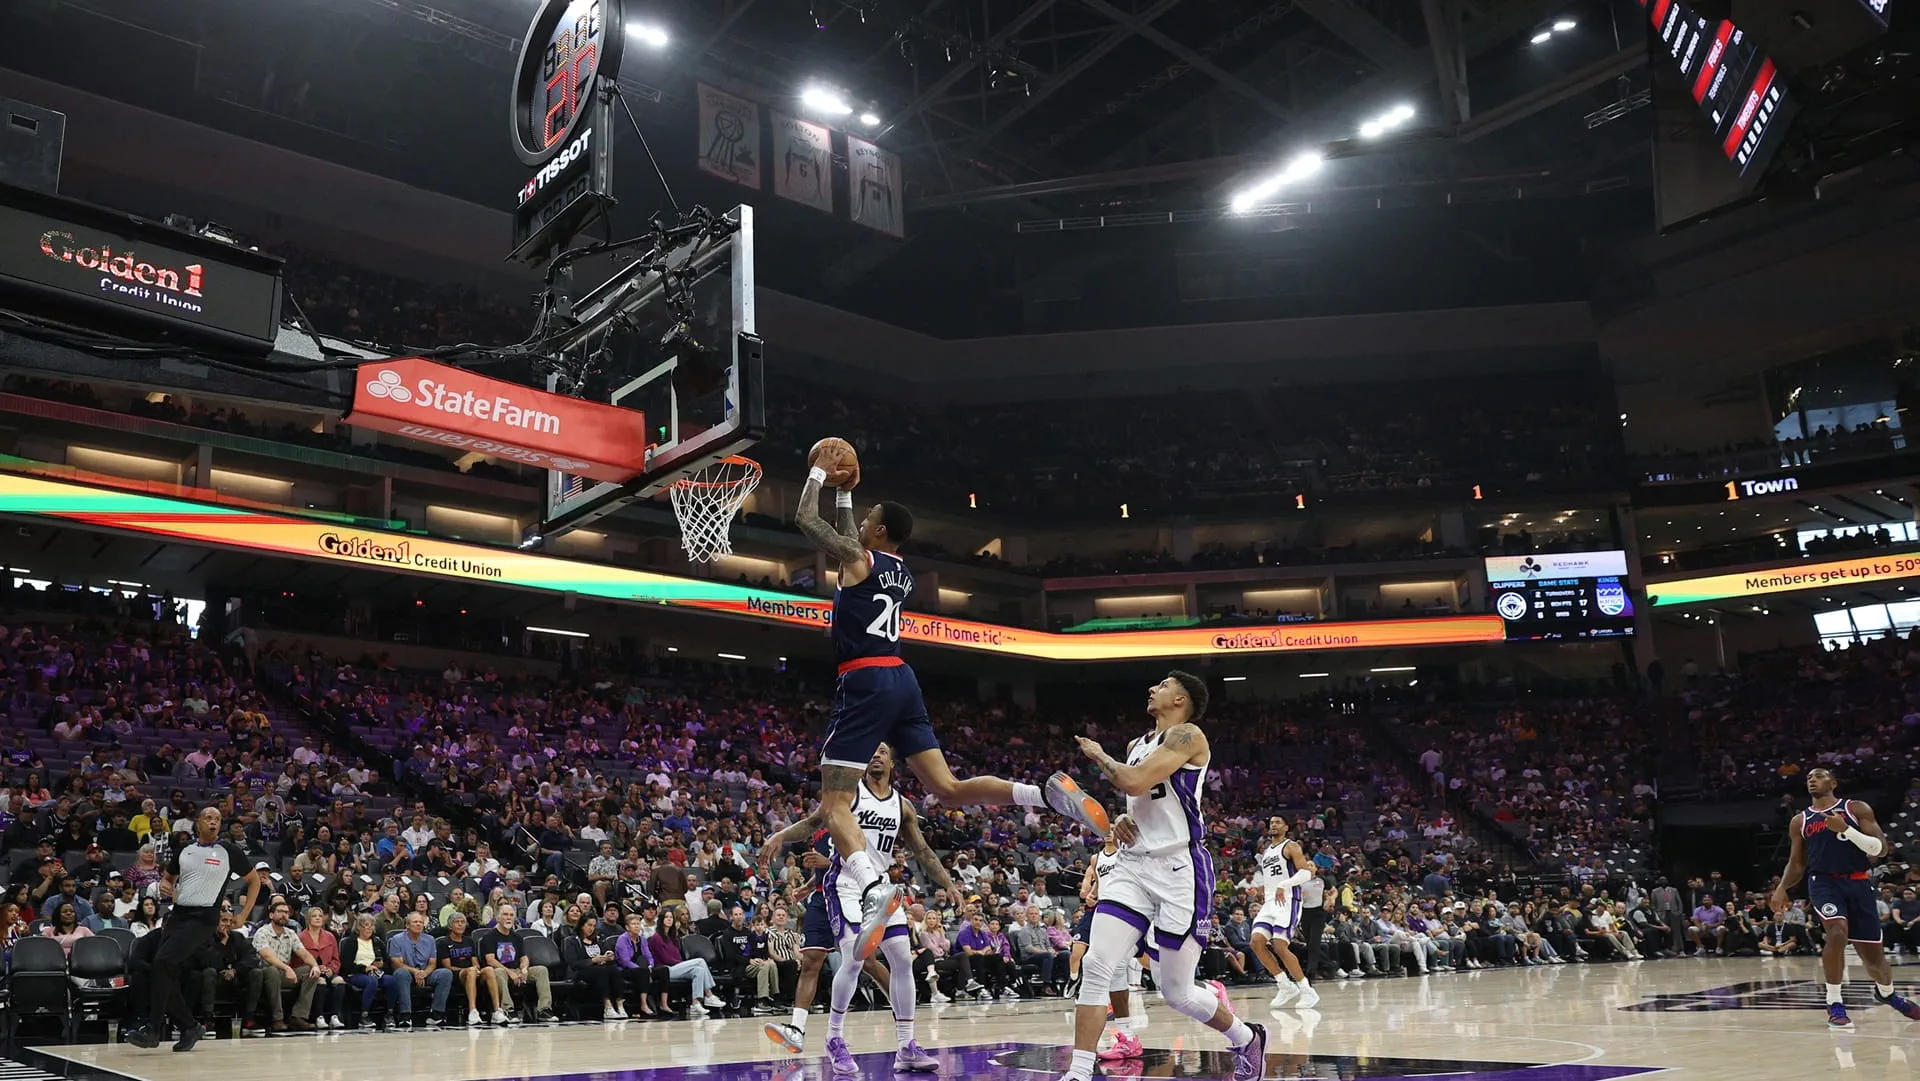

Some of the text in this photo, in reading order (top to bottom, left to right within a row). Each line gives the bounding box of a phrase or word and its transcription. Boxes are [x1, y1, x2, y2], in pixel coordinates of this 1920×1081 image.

[1707, 38, 1723, 68] FOULS
[1737, 89, 1760, 130] TIMEOUTS
[536, 127, 592, 190] TISSOT
[100, 278, 150, 299] Credit
[1725, 476, 1798, 500] 1 Town
[414, 553, 459, 572] Credit
[461, 560, 502, 578] Union
[1745, 573, 1816, 590] Members
[1821, 567, 1848, 584] get
[1850, 566, 1870, 582] up
[1874, 563, 1891, 575] to
[1492, 581, 1526, 589] CLIPPERS
[1558, 578, 1579, 586] STATS
[747, 595, 819, 620] Members
[922, 620, 942, 637] off
[944, 623, 980, 642] home
[866, 593, 903, 642] 20
[1285, 635, 1322, 647] Credit
[1323, 633, 1358, 645] Union
[857, 809, 898, 831] Kings
[876, 833, 895, 853] 10
[1270, 864, 1283, 877] 32
